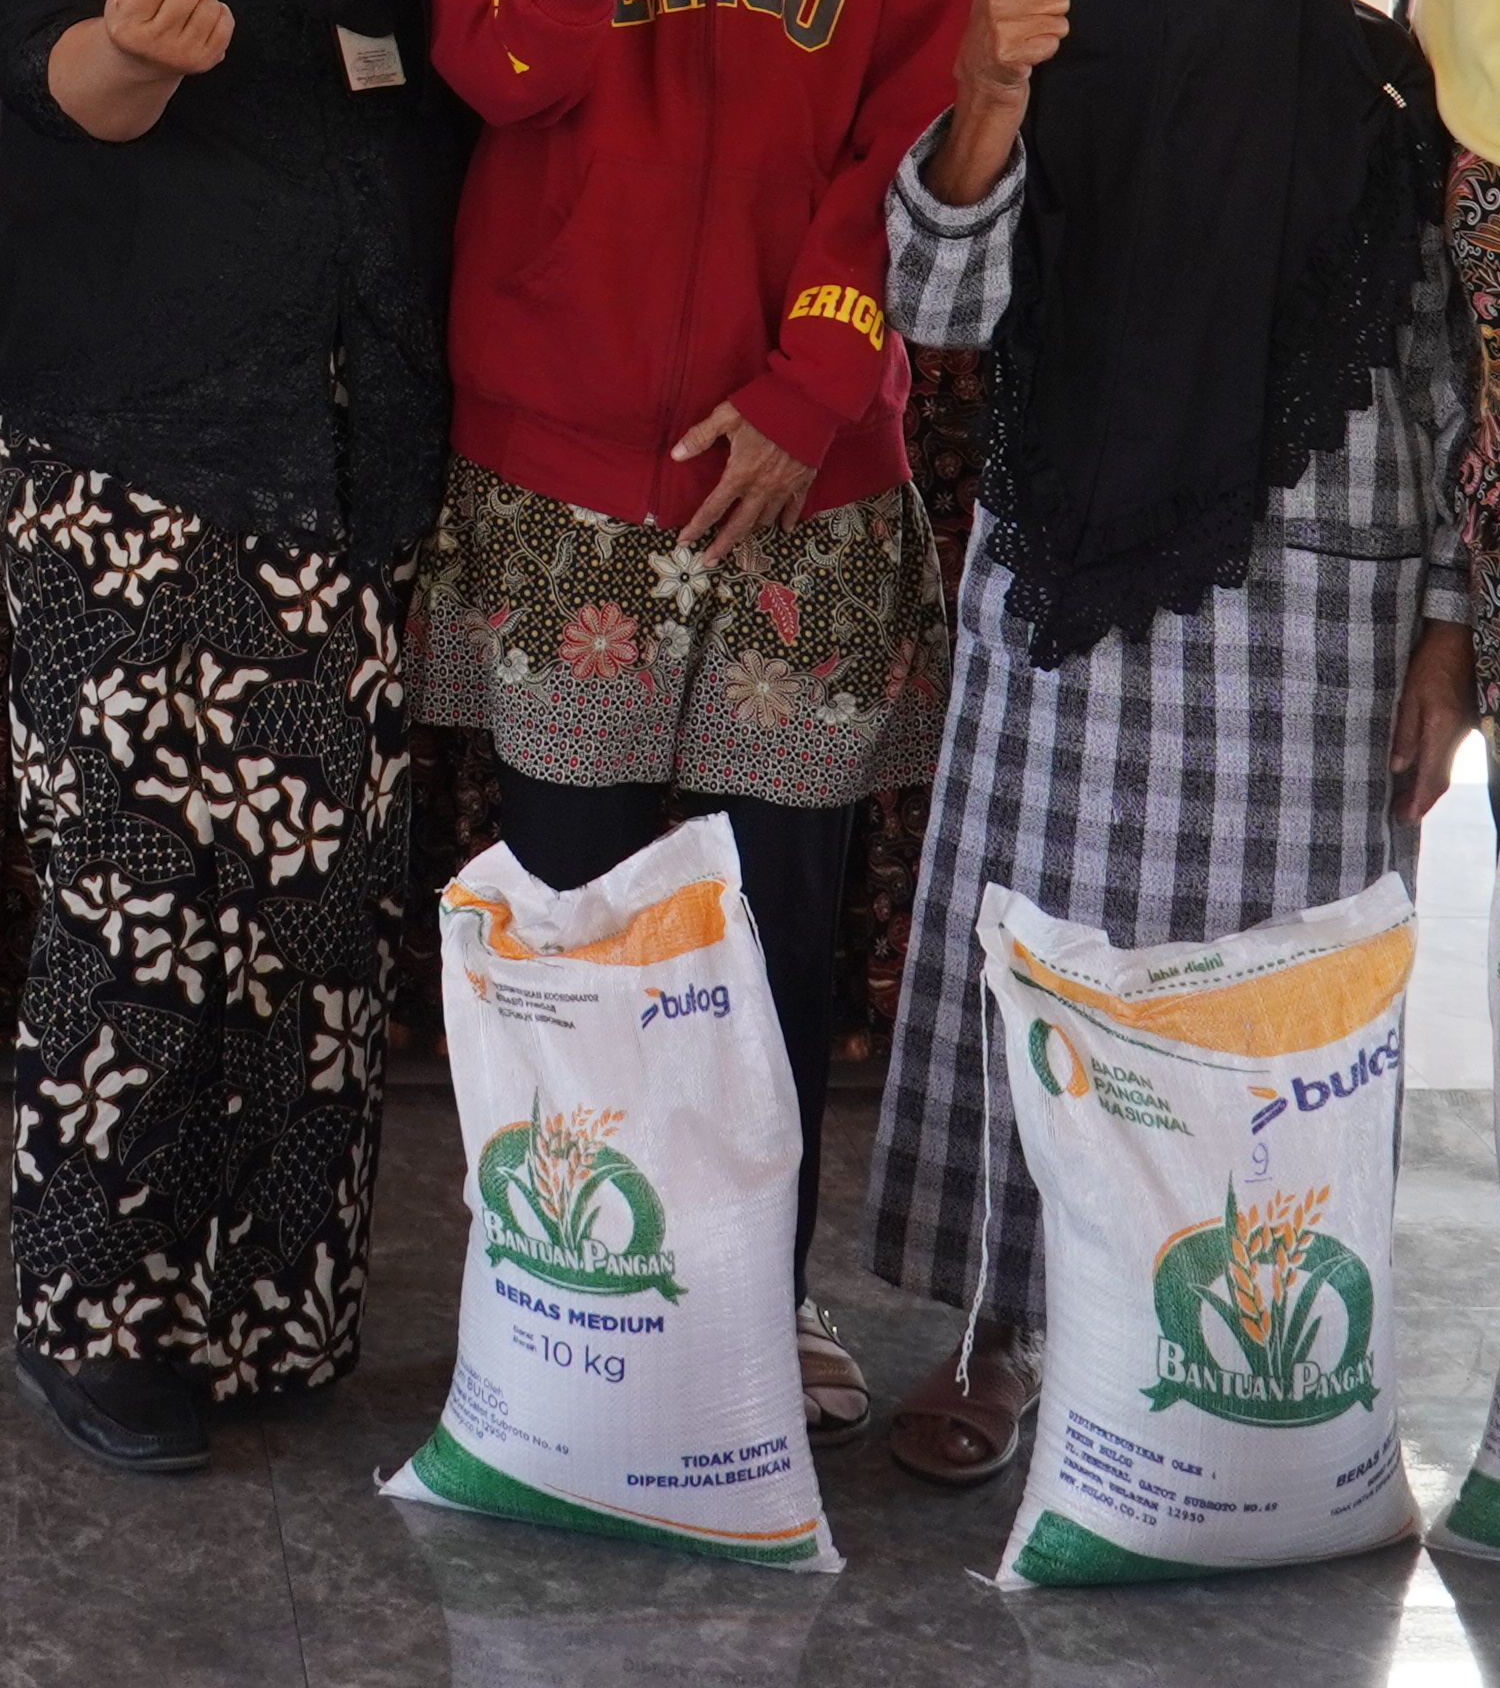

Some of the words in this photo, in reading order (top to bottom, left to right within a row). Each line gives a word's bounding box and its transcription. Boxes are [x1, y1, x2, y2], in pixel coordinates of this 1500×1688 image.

[788, 284, 885, 351] ERIGO
[659, 983, 730, 1020] bulog
[1091, 1055, 1154, 1090] BADAN
[1094, 1077, 1171, 1113] PANGAN
[1099, 1095, 1196, 1137] NASIONAL
[482, 1205, 579, 1269] BANTUAN
[581, 1238, 675, 1278] PANGAN
[495, 1278, 560, 1321] BERAS
[568, 1308, 664, 1334] MEDIUM
[541, 1335, 573, 1367] 10
[585, 1344, 625, 1383] kg
[1157, 1336, 1284, 1402] BANTUAN
[1293, 1351, 1374, 1401] PANGAN
[467, 1377, 509, 1416] BULOG
[491, 1413, 530, 1441] Subroto
[533, 1435, 551, 1451] No.
[555, 1443, 570, 1455] 49
[681, 1451, 735, 1468] TIDAK
[739, 1436, 789, 1462] UNTUK
[627, 1457, 791, 1488] DIPERJUALBELIKAN
[1099, 1444, 1134, 1468] BULOG
[1171, 1459, 1203, 1477] OLEH
[1336, 1449, 1379, 1487] BERAS
[1139, 1479, 1177, 1501] GATOT
[1183, 1495, 1237, 1512] SUBROTO
[1168, 1505, 1205, 1524] 12950
